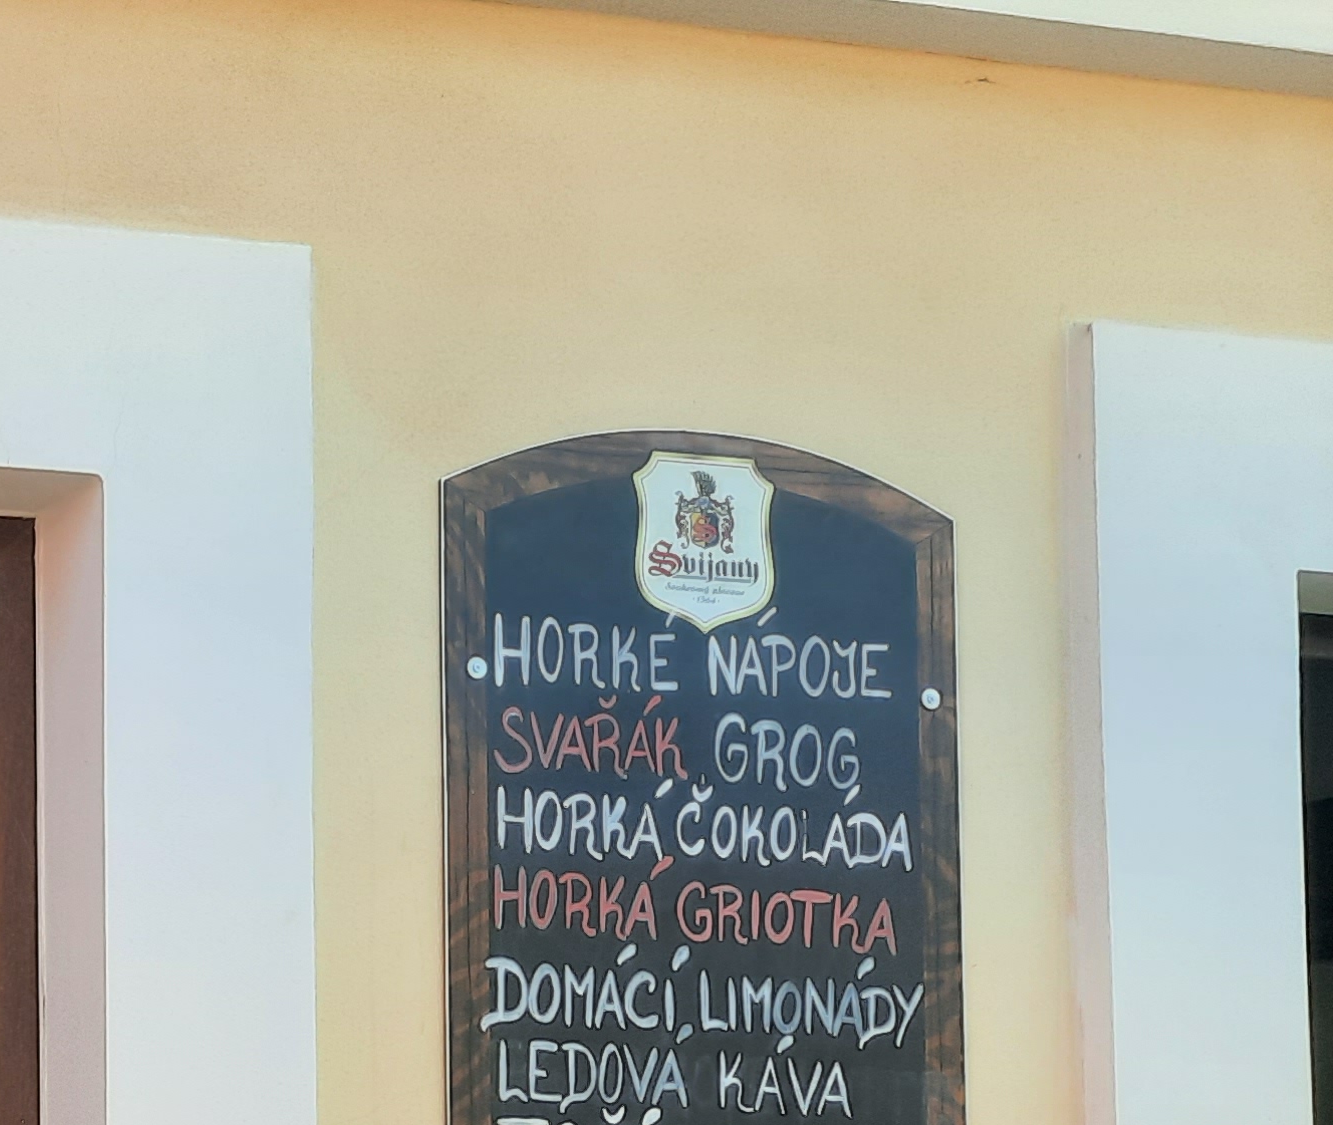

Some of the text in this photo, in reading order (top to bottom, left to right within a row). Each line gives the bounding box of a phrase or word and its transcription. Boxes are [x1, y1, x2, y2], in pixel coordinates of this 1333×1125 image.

[648, 540, 759, 587] Svijany
[493, 608, 892, 699] HORKÉ NÁPOJE
[493, 695, 862, 792] SVAŘÁK GROG
[495, 779, 914, 873] HORKÁ ČOKOLÁDA
[493, 857, 897, 956] HORKÁ GRIOTKA
[480, 945, 924, 1049] DOMÁCÍ LIMONÁDY
[497, 1025, 853, 1119] LEDOVÁ KÁVA
